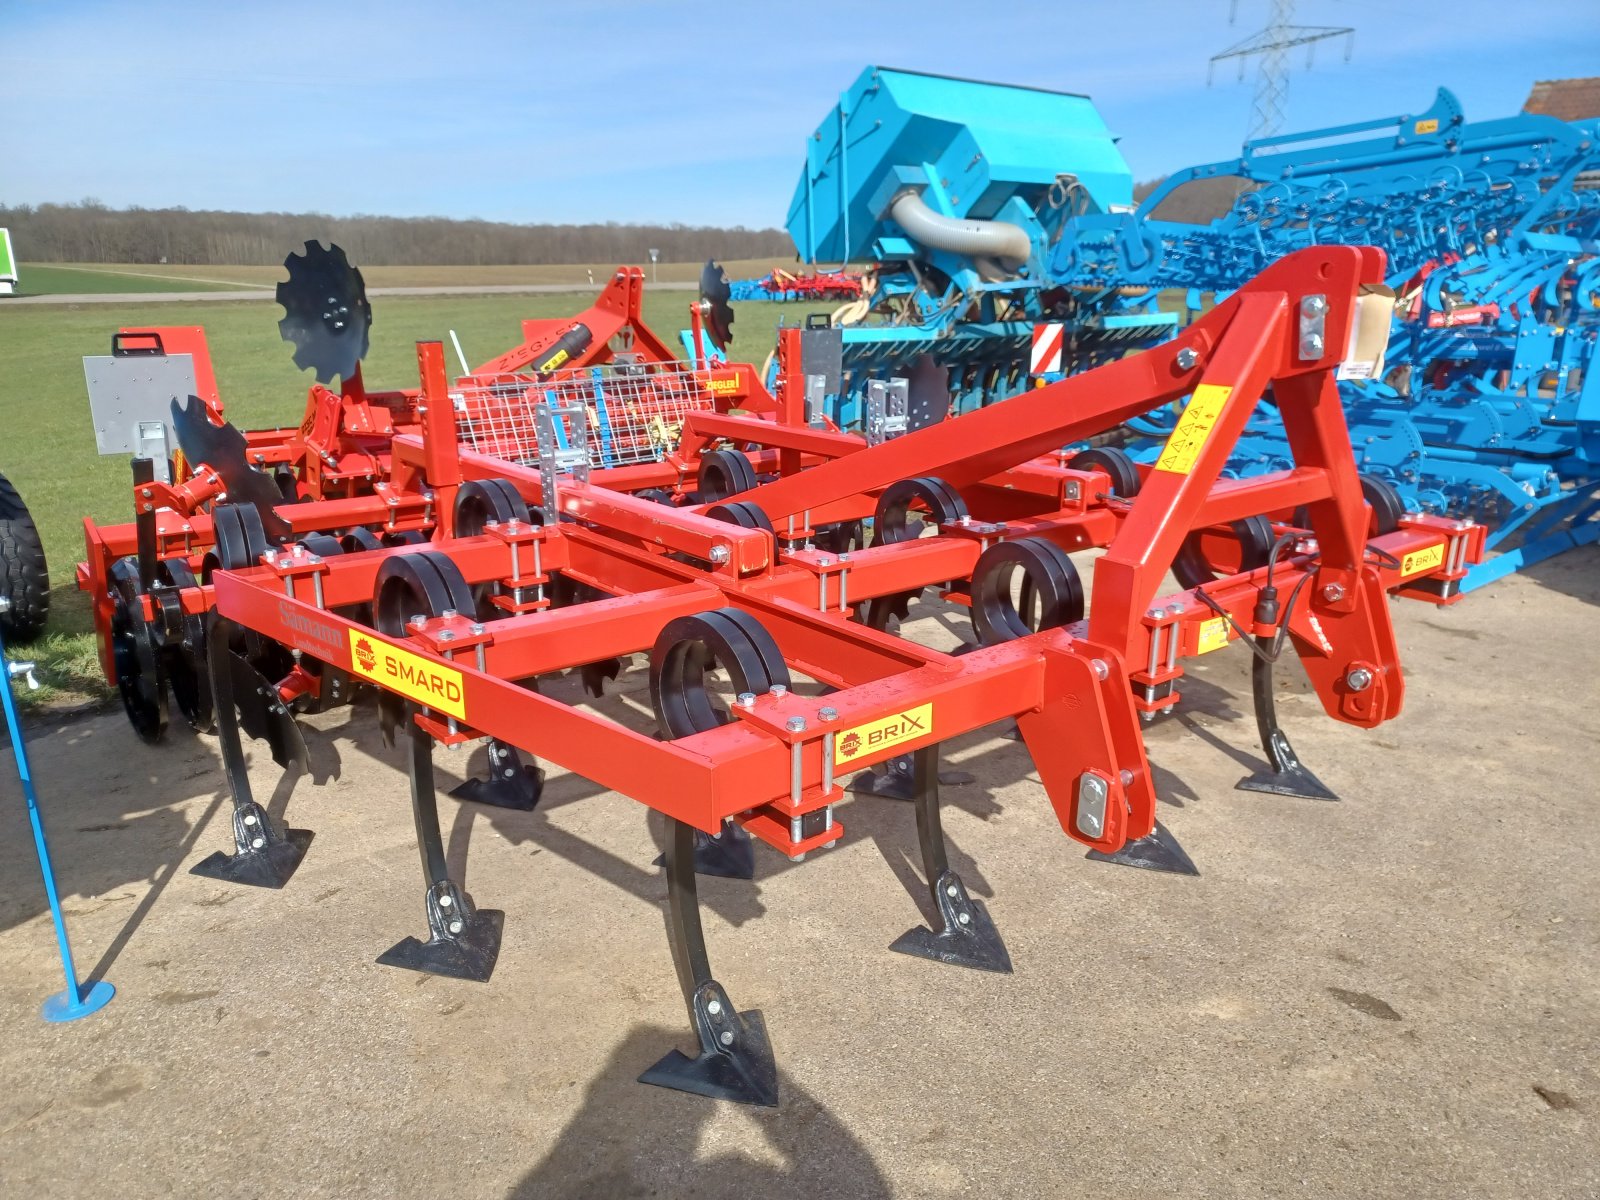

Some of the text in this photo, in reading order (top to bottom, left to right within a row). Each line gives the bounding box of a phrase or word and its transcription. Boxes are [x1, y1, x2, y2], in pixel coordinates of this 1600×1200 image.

[1415, 549, 1439, 566] BRIX
[355, 647, 377, 664] BRIX
[385, 655, 461, 703] SMARD
[868, 714, 925, 745] BRIX
